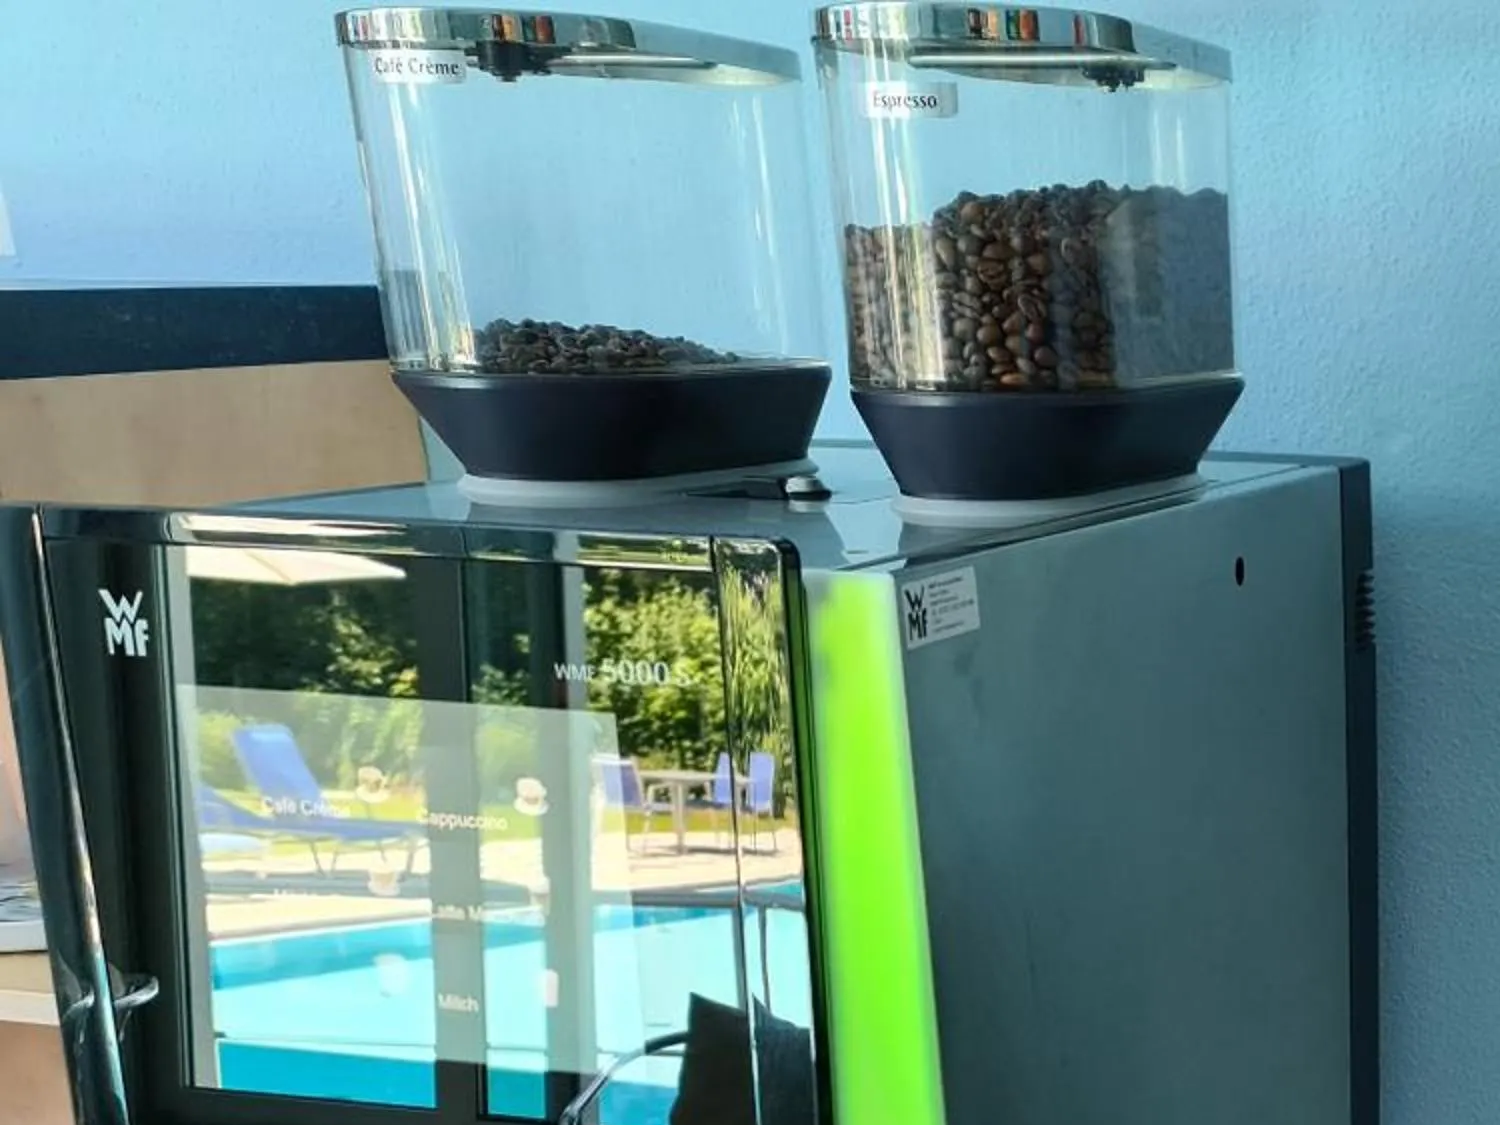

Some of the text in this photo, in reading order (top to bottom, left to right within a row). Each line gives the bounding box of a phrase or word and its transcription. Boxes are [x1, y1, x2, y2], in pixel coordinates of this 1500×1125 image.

[375, 57, 459, 75] Café Crème
[873, 90, 938, 111] Espresso
[600, 657, 670, 686] 5000
